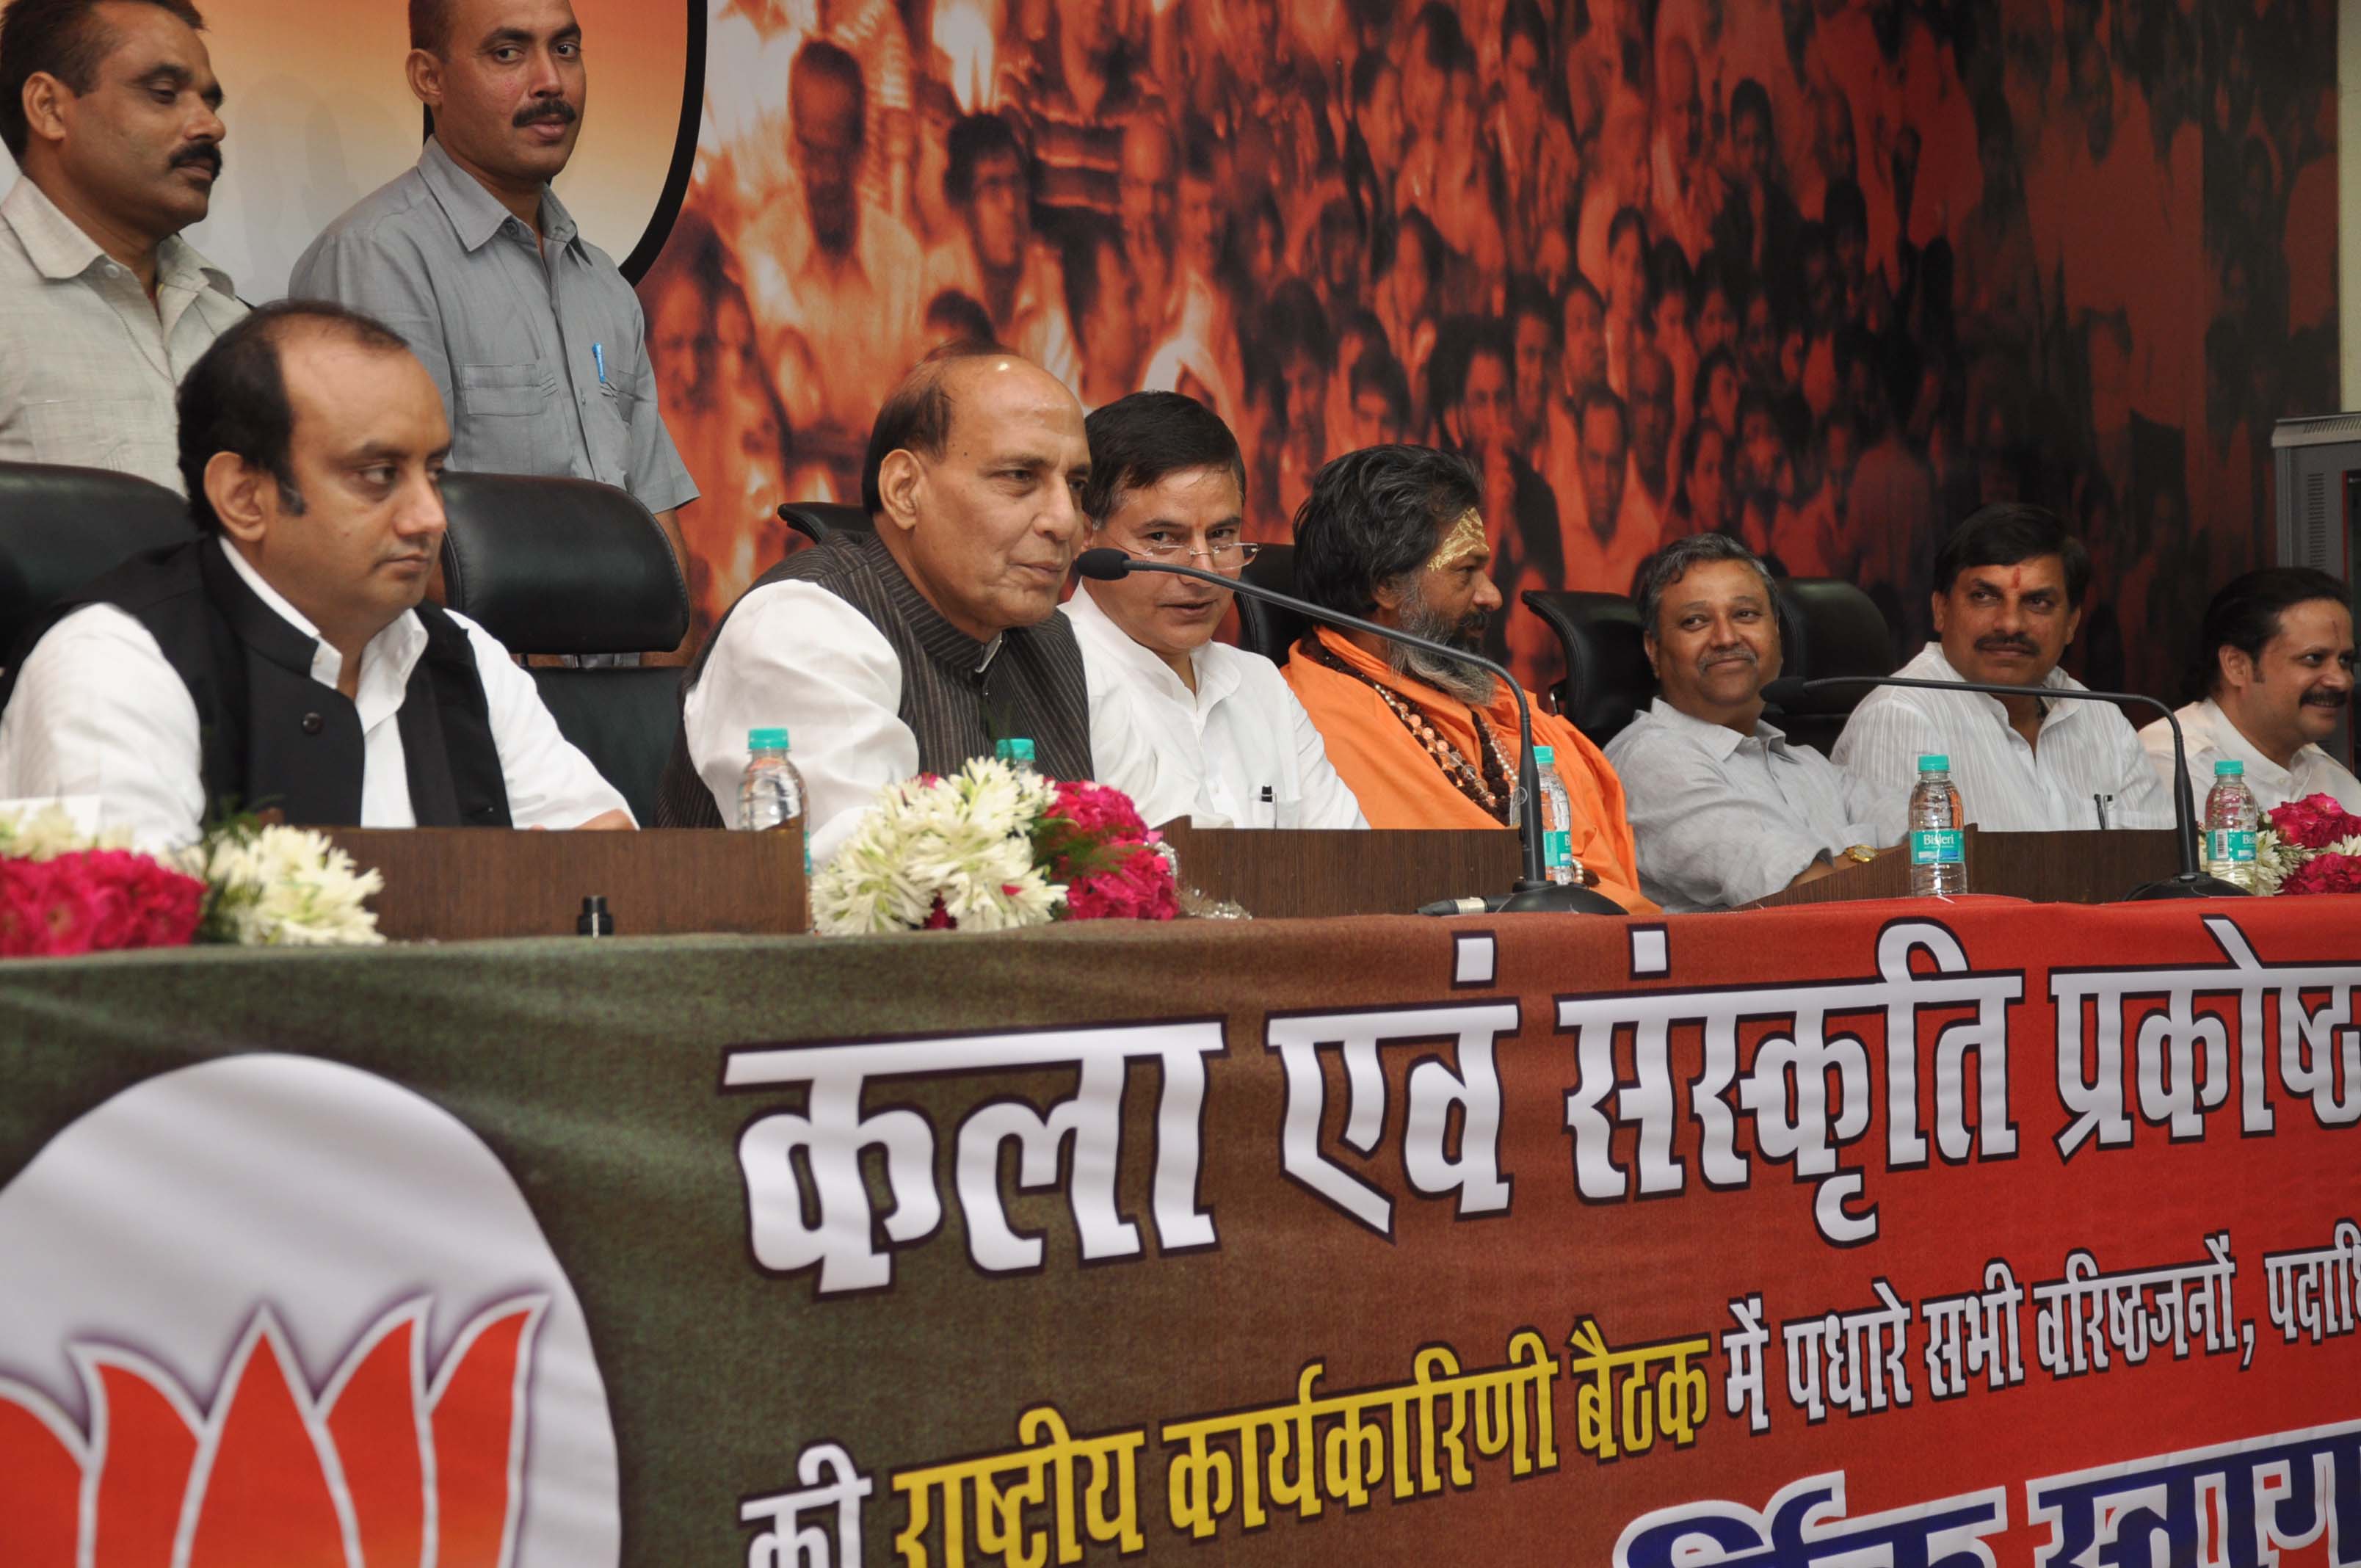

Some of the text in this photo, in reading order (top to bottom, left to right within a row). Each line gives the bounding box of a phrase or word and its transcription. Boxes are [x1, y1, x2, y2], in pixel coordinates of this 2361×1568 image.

[722, 1019, 1226, 1295] कला
[1264, 934, 1522, 1238] एवं
[1555, 921, 2026, 1244] संस्कृति
[1161, 1330, 1560, 1539] कार्यकारिणी
[1568, 1318, 1711, 1460] बैठक
[1722, 1296, 1770, 1432] में
[1782, 1281, 1912, 1421] पधारे
[1921, 1261, 2025, 1397] सभी
[2032, 1233, 2255, 1370] वरिष्ठजनों,
